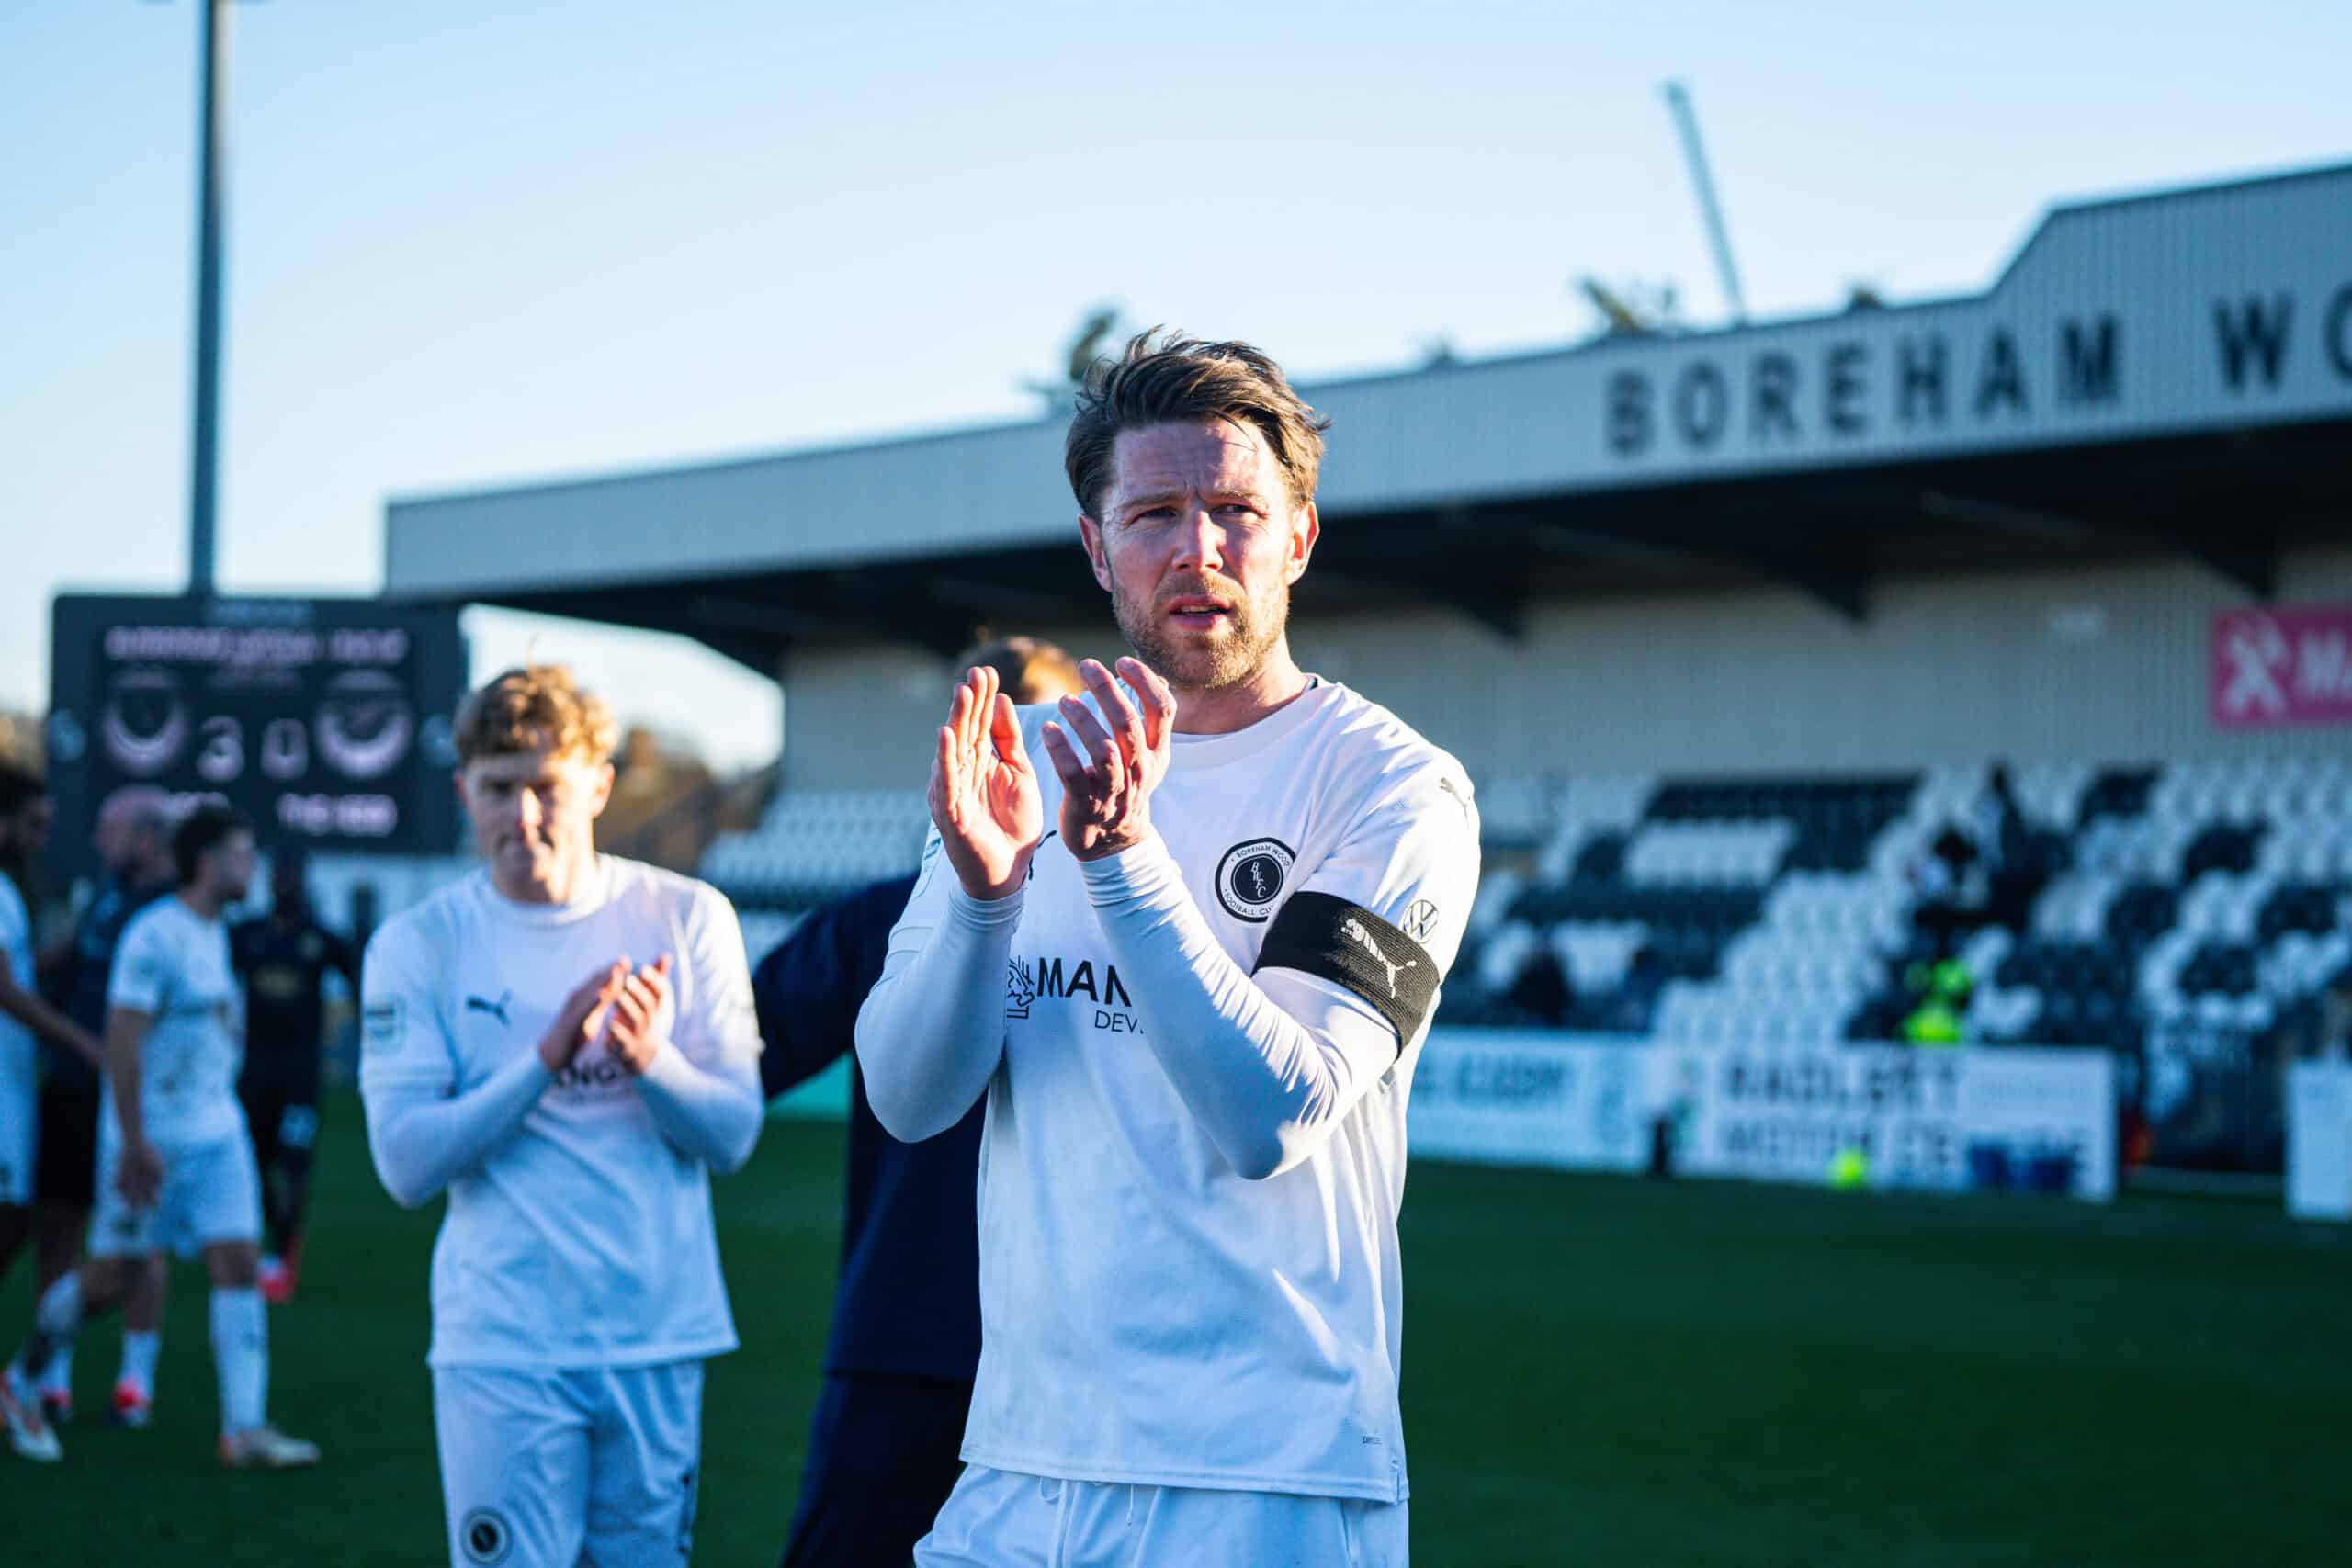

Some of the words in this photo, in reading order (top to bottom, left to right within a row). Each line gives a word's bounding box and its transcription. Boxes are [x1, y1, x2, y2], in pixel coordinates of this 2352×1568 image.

[1604, 311, 2120, 456] BOREHAM
[196, 715, 245, 782] 3
[262, 717, 309, 782] 0
[1236, 844, 1272, 859] BOREHAM
[1272, 848, 1290, 867] WOOD
[1225, 891, 1255, 916] FOOTBALL
[1259, 903, 1274, 916] CLU
[1095, 1010, 1145, 1035] DEV
